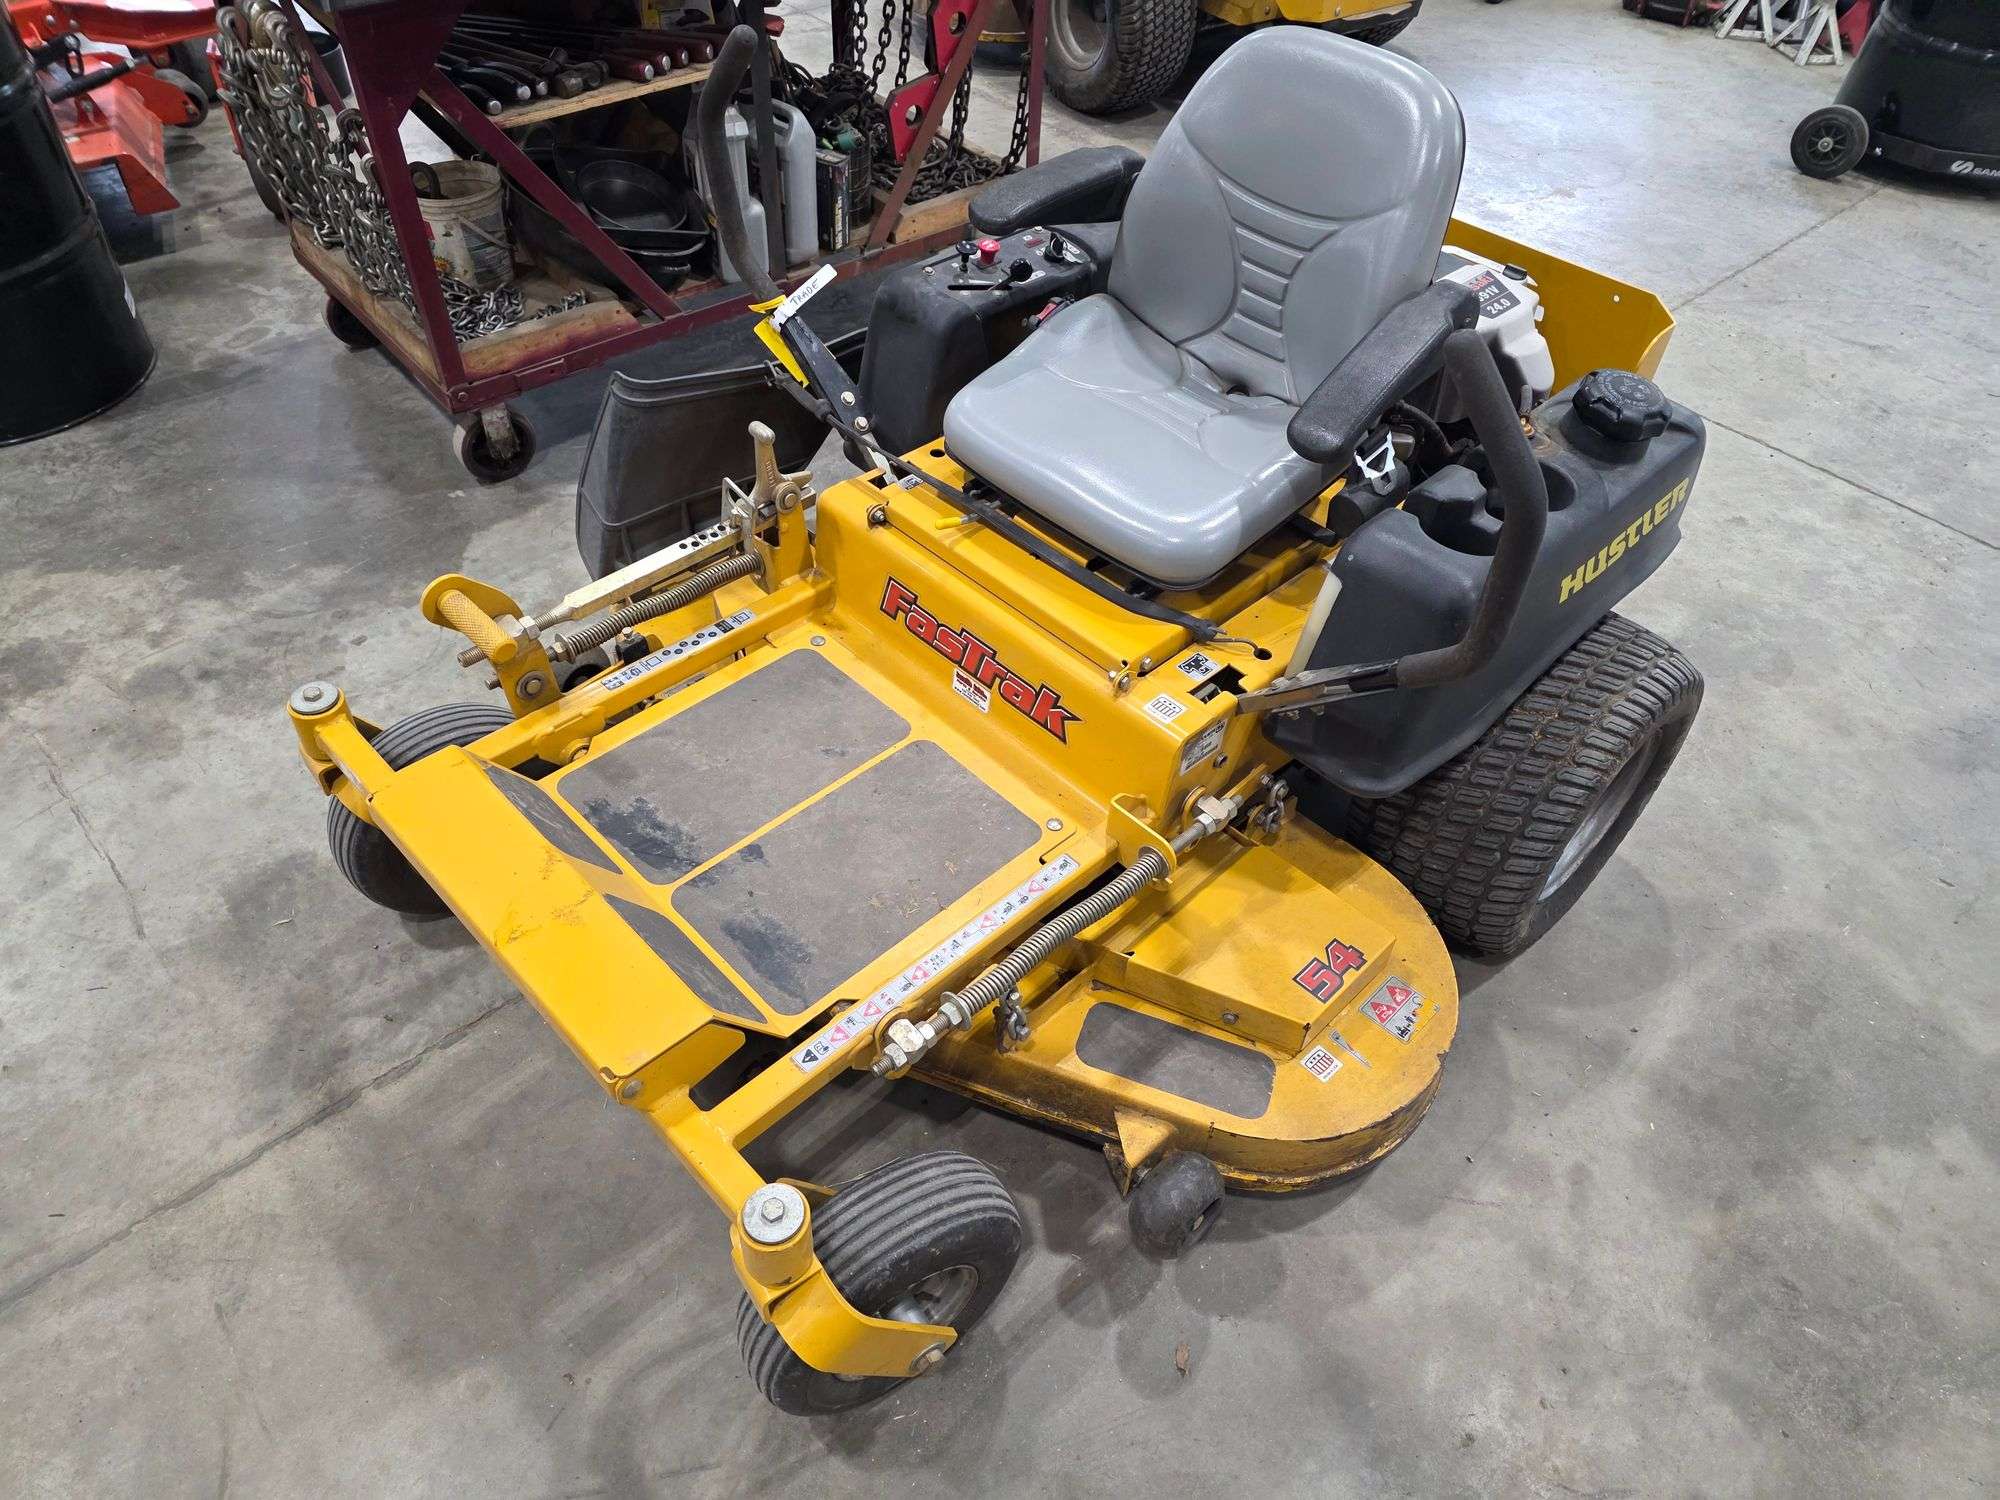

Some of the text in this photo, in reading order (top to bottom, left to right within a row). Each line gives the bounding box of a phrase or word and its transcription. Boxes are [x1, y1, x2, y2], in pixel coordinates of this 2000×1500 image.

[789, 278, 819, 306] TRADE
[1487, 298, 1511, 315] 24.0
[1559, 477, 1689, 604] HUSTLER
[880, 576, 1083, 745] FasTrak
[1292, 937, 1368, 1004] 54
